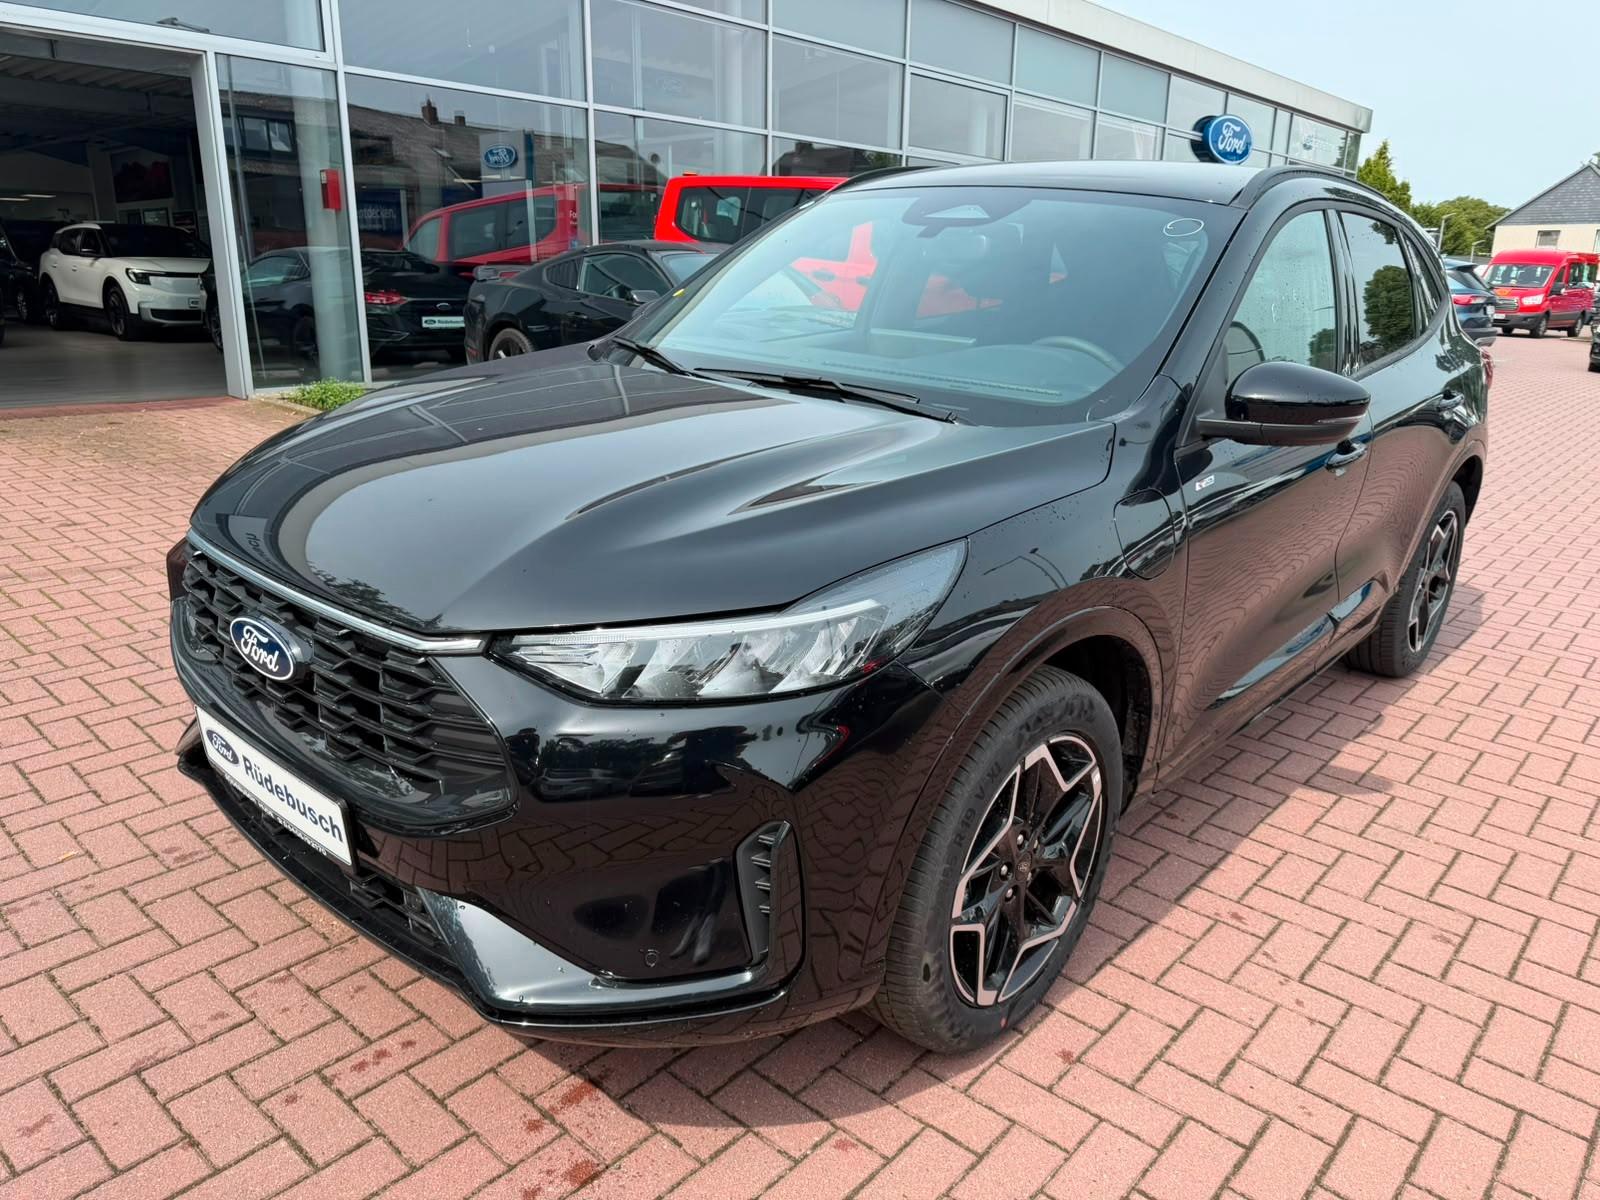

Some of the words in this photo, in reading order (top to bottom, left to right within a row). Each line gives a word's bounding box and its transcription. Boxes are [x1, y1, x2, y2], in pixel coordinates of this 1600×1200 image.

[1218, 121, 1246, 154] Ford
[240, 625, 280, 674] Ford
[211, 734, 235, 763] Ford
[242, 754, 344, 843] Rüdebusch
